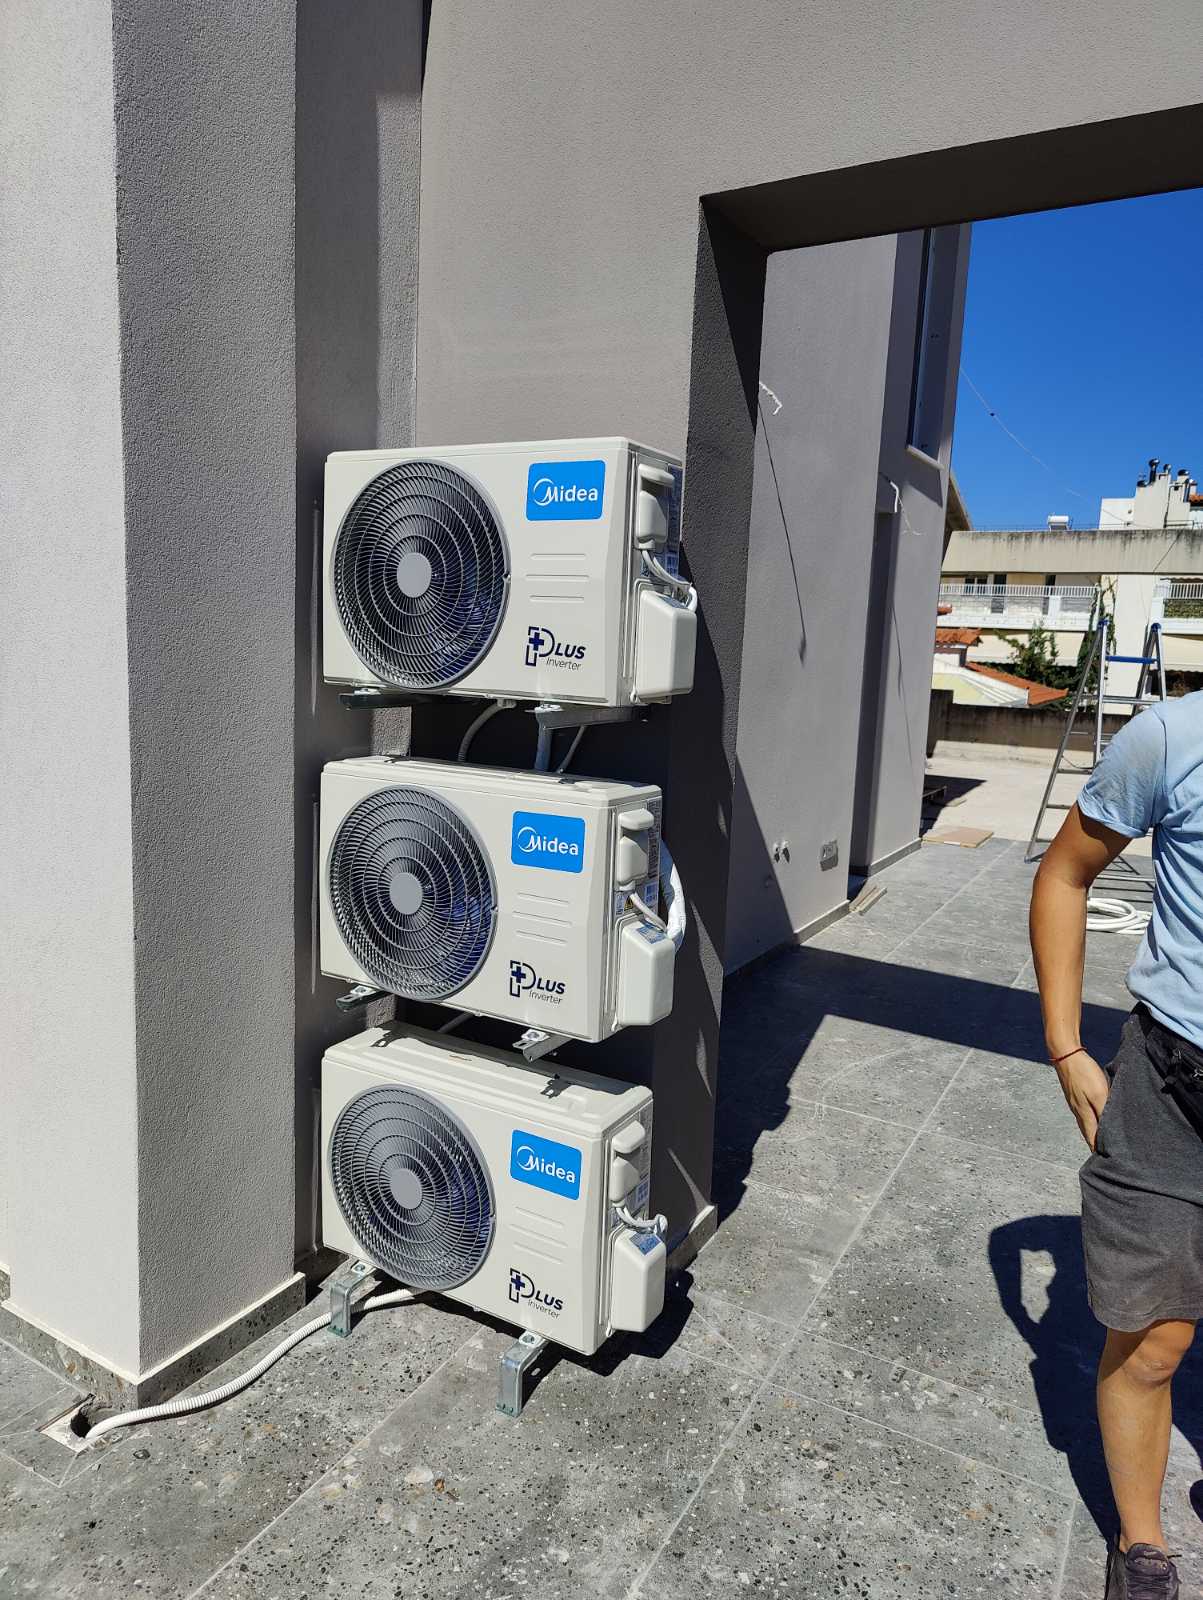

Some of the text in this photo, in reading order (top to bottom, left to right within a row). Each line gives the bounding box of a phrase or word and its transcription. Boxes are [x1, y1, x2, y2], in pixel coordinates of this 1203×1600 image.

[533, 478, 599, 506] Midea
[525, 626, 587, 667] PLUS
[517, 826, 579, 856] Midea
[509, 960, 566, 998] PLUS
[516, 1145, 576, 1184] Midea
[508, 1267, 564, 1310] PLUS
